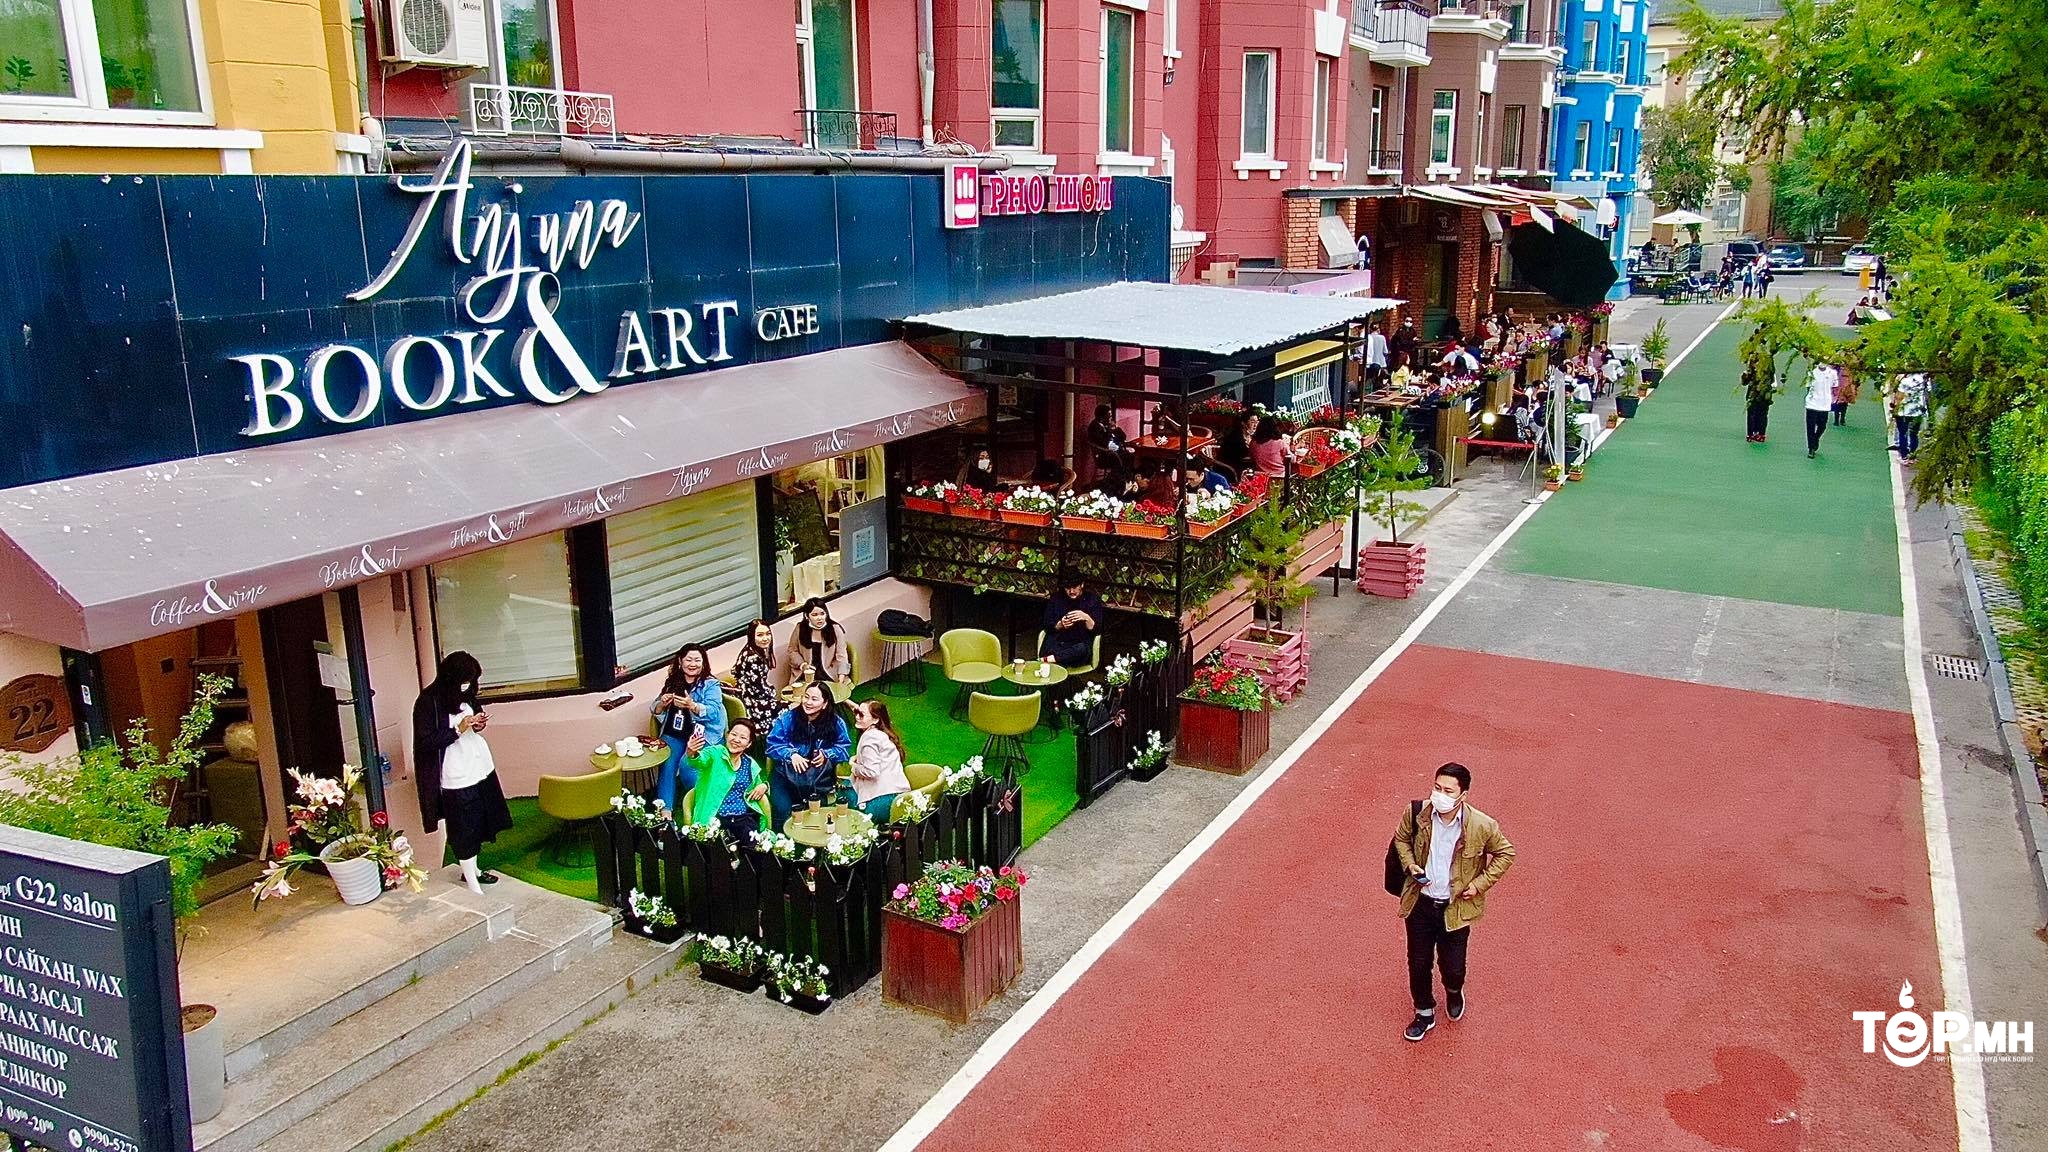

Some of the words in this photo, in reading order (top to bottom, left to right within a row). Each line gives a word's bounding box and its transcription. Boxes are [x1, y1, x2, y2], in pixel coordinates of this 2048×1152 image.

[227, 328, 515, 436] BOOK
[606, 299, 739, 378] ART
[754, 304, 820, 342] CAFE
[8, 698, 58, 743] 22
[16, 874, 58, 907] G22
[62, 891, 118, 923] salon
[5, 946, 81, 989] САЙХАН,
[82, 968, 124, 998] WAX
[29, 982, 84, 1017] ЗАСАЛ
[42, 1016, 119, 1059] МАССАЖ
